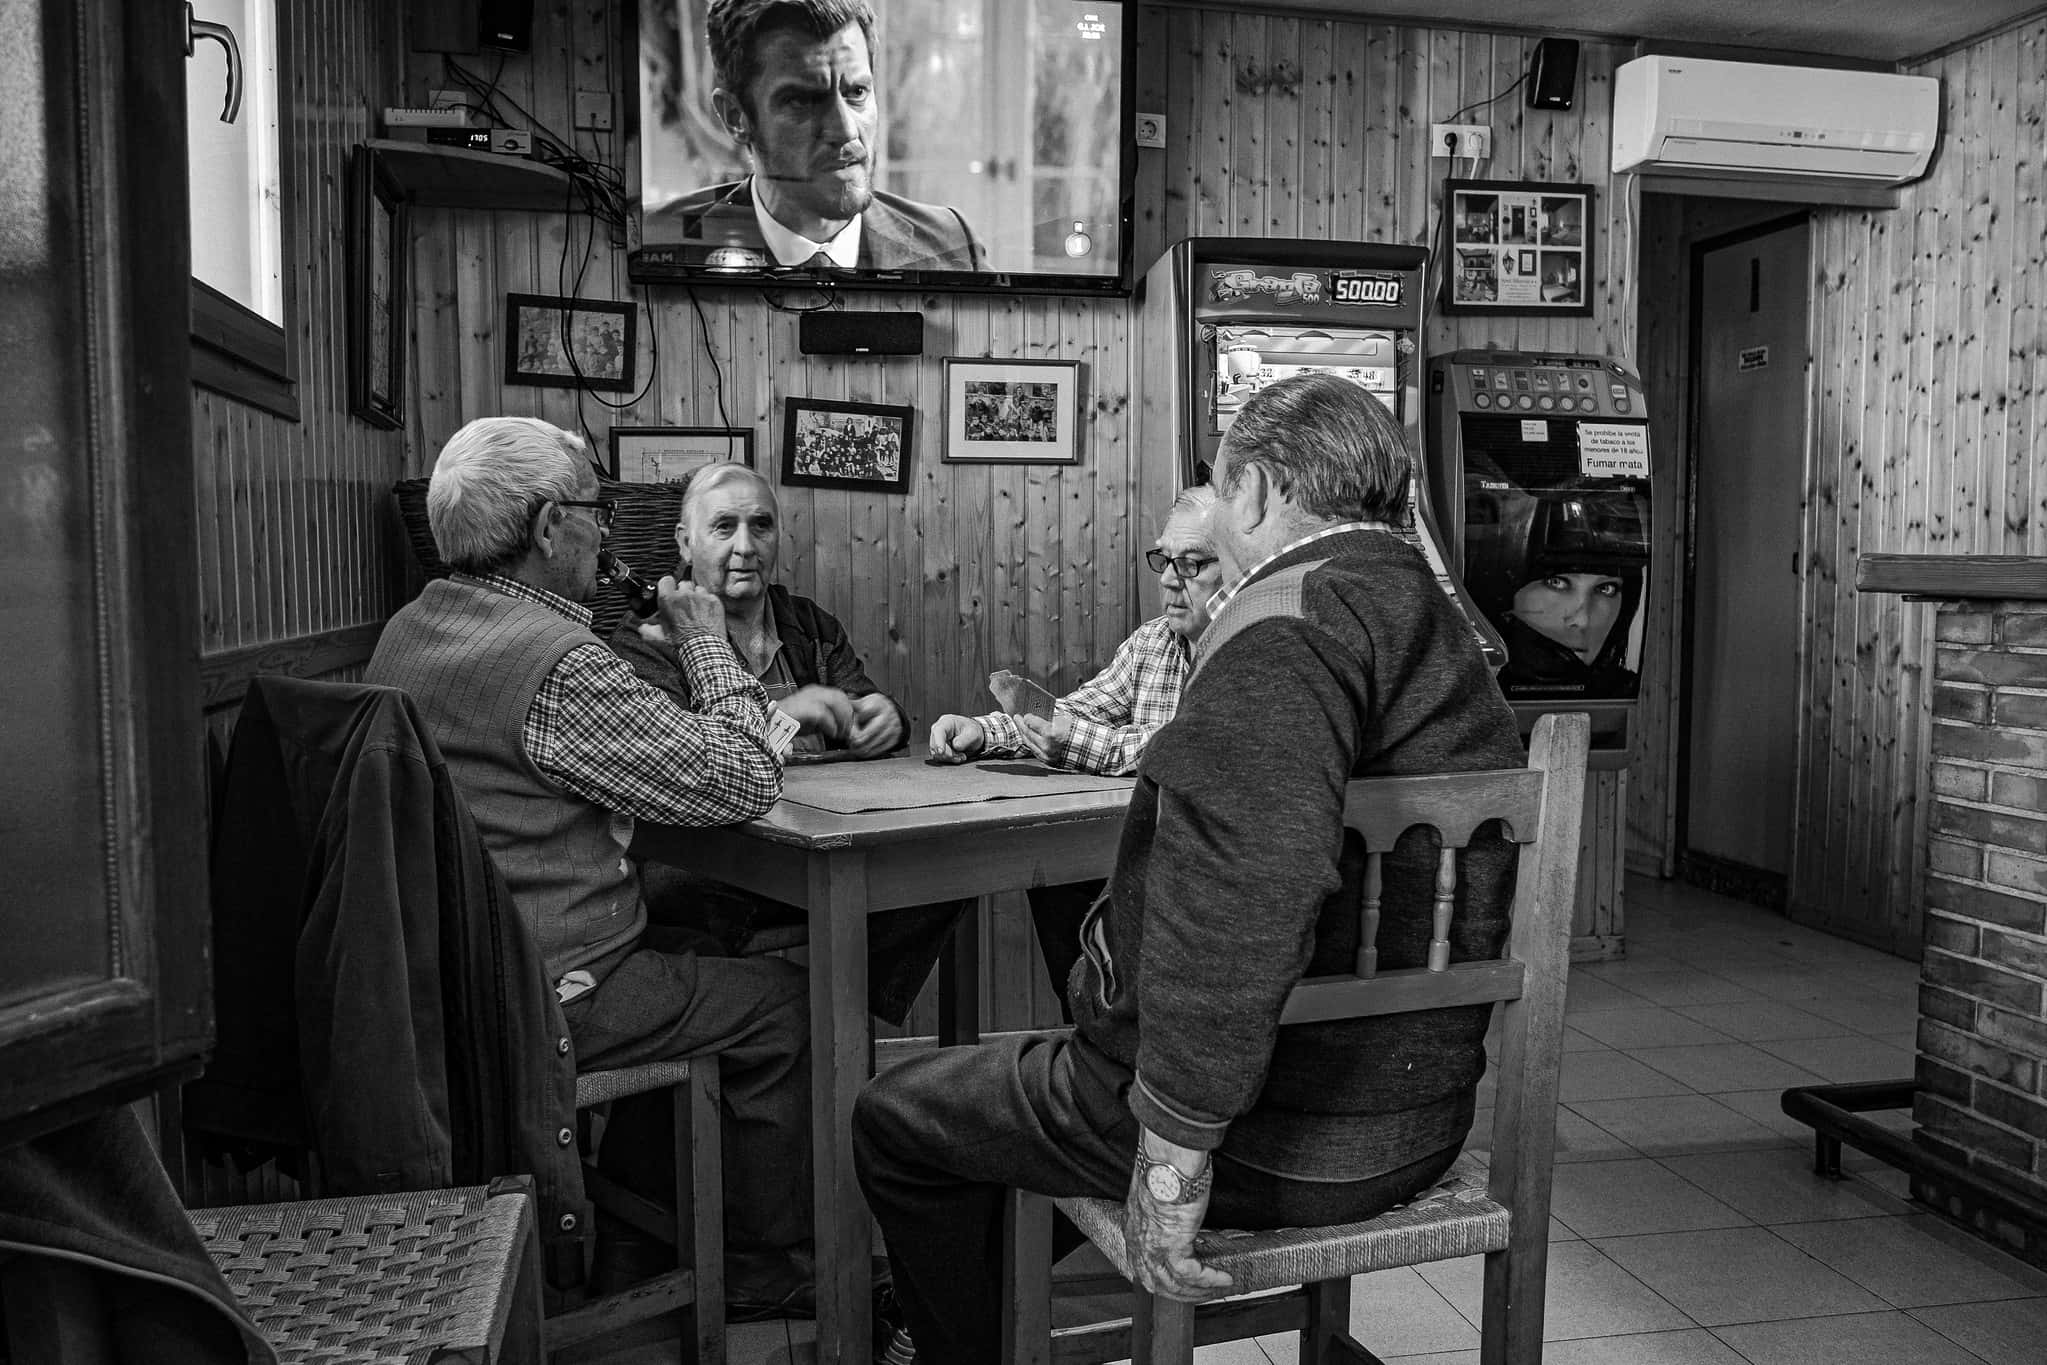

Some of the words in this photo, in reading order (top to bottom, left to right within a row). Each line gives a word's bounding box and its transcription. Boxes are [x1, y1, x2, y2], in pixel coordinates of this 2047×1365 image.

[1302, 294, 1320, 305] 500
[1587, 458, 1616, 468] Fumar
[1619, 460, 1643, 469] mata
